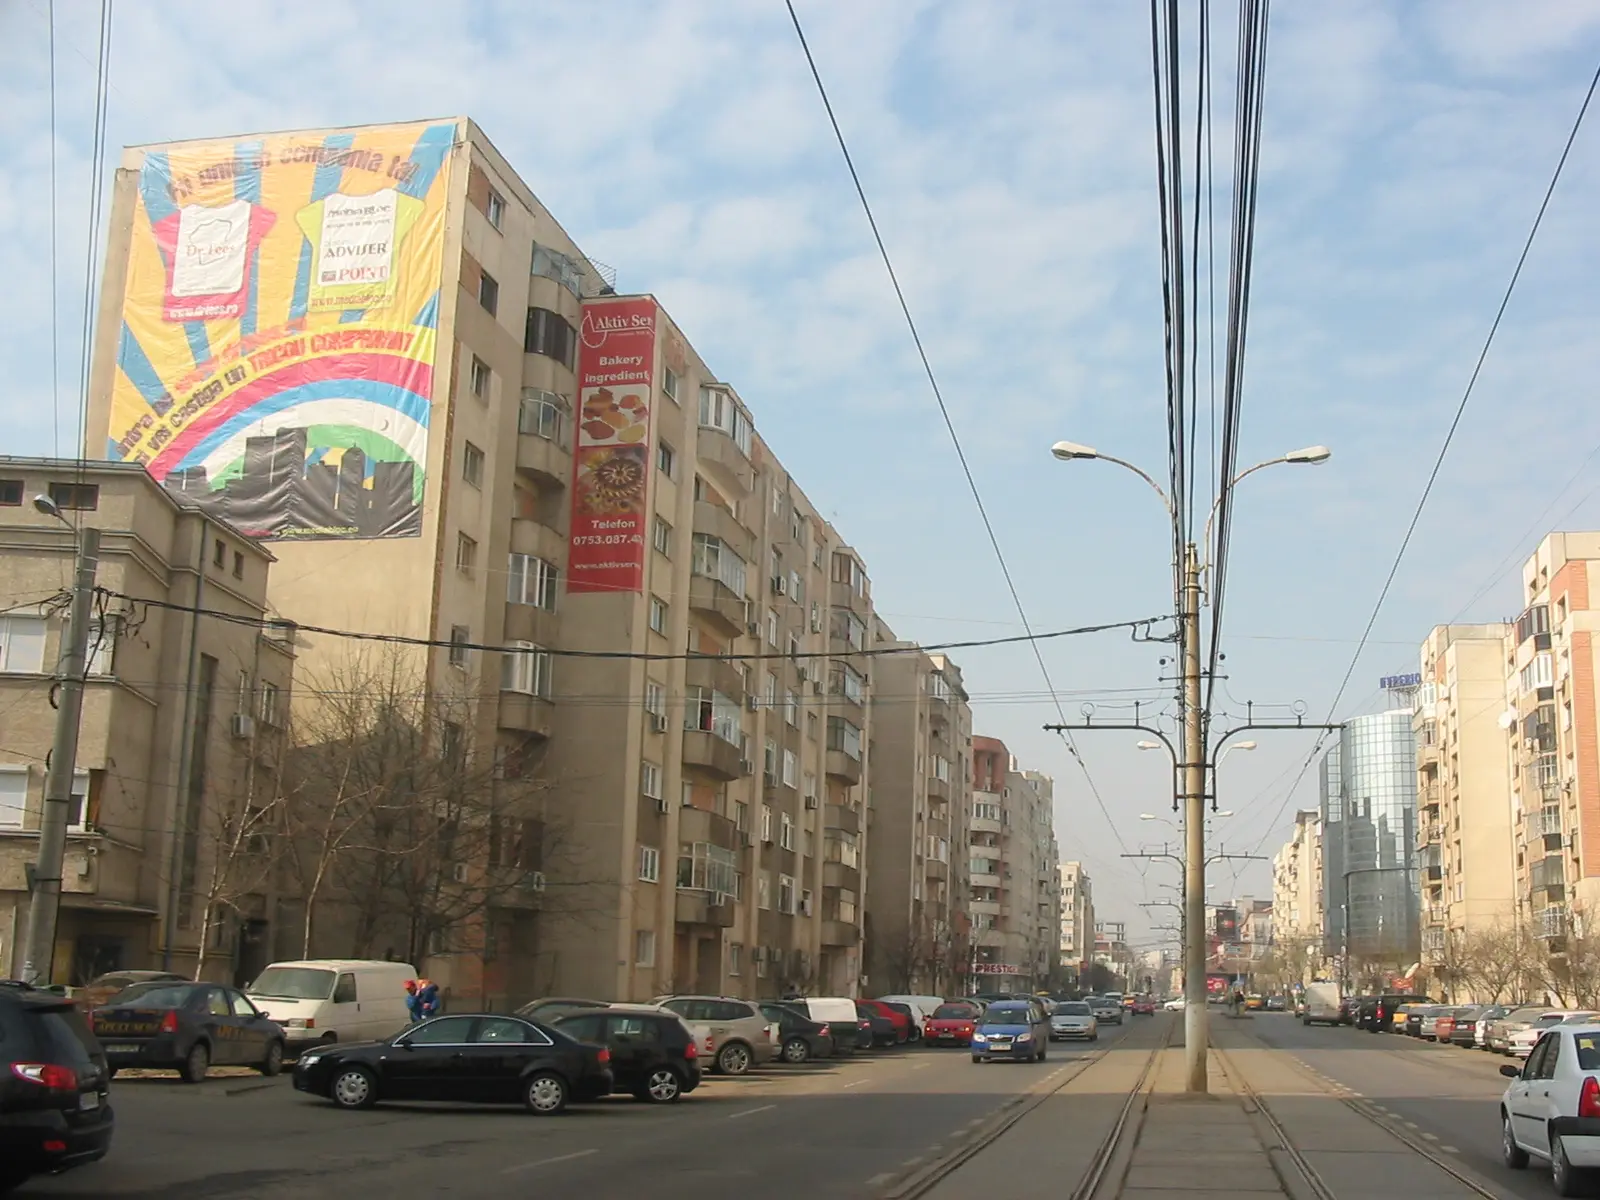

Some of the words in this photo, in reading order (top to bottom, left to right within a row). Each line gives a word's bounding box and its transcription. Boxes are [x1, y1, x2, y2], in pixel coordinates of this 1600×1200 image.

[323, 241, 387, 259] ADVISER
[595, 314, 629, 330] Aktiv
[599, 355, 643, 367] Bakery
[591, 519, 637, 530] Telefon
